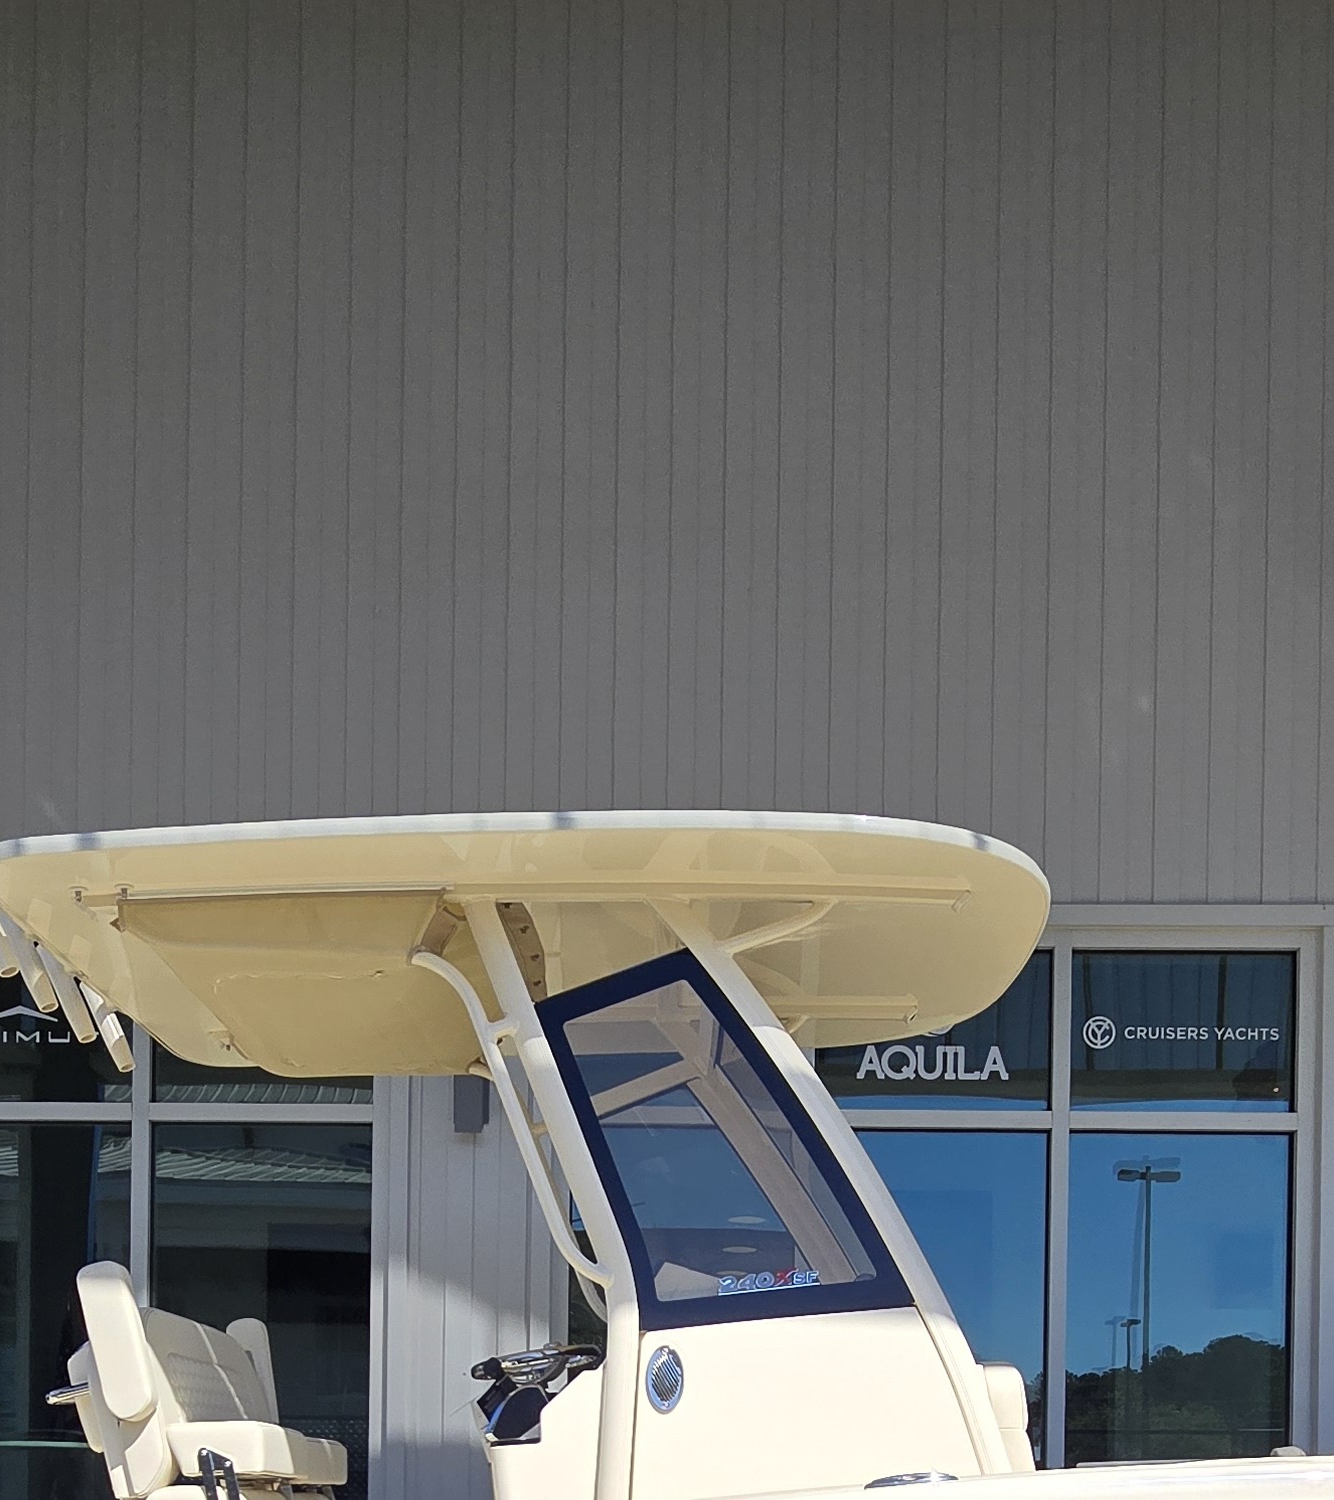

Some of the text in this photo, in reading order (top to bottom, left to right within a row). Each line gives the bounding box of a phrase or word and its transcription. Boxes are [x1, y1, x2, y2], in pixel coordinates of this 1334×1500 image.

[1124, 1026, 1280, 1041] CRUISERS YACHTS
[856, 1044, 1009, 1081] AQUILA
